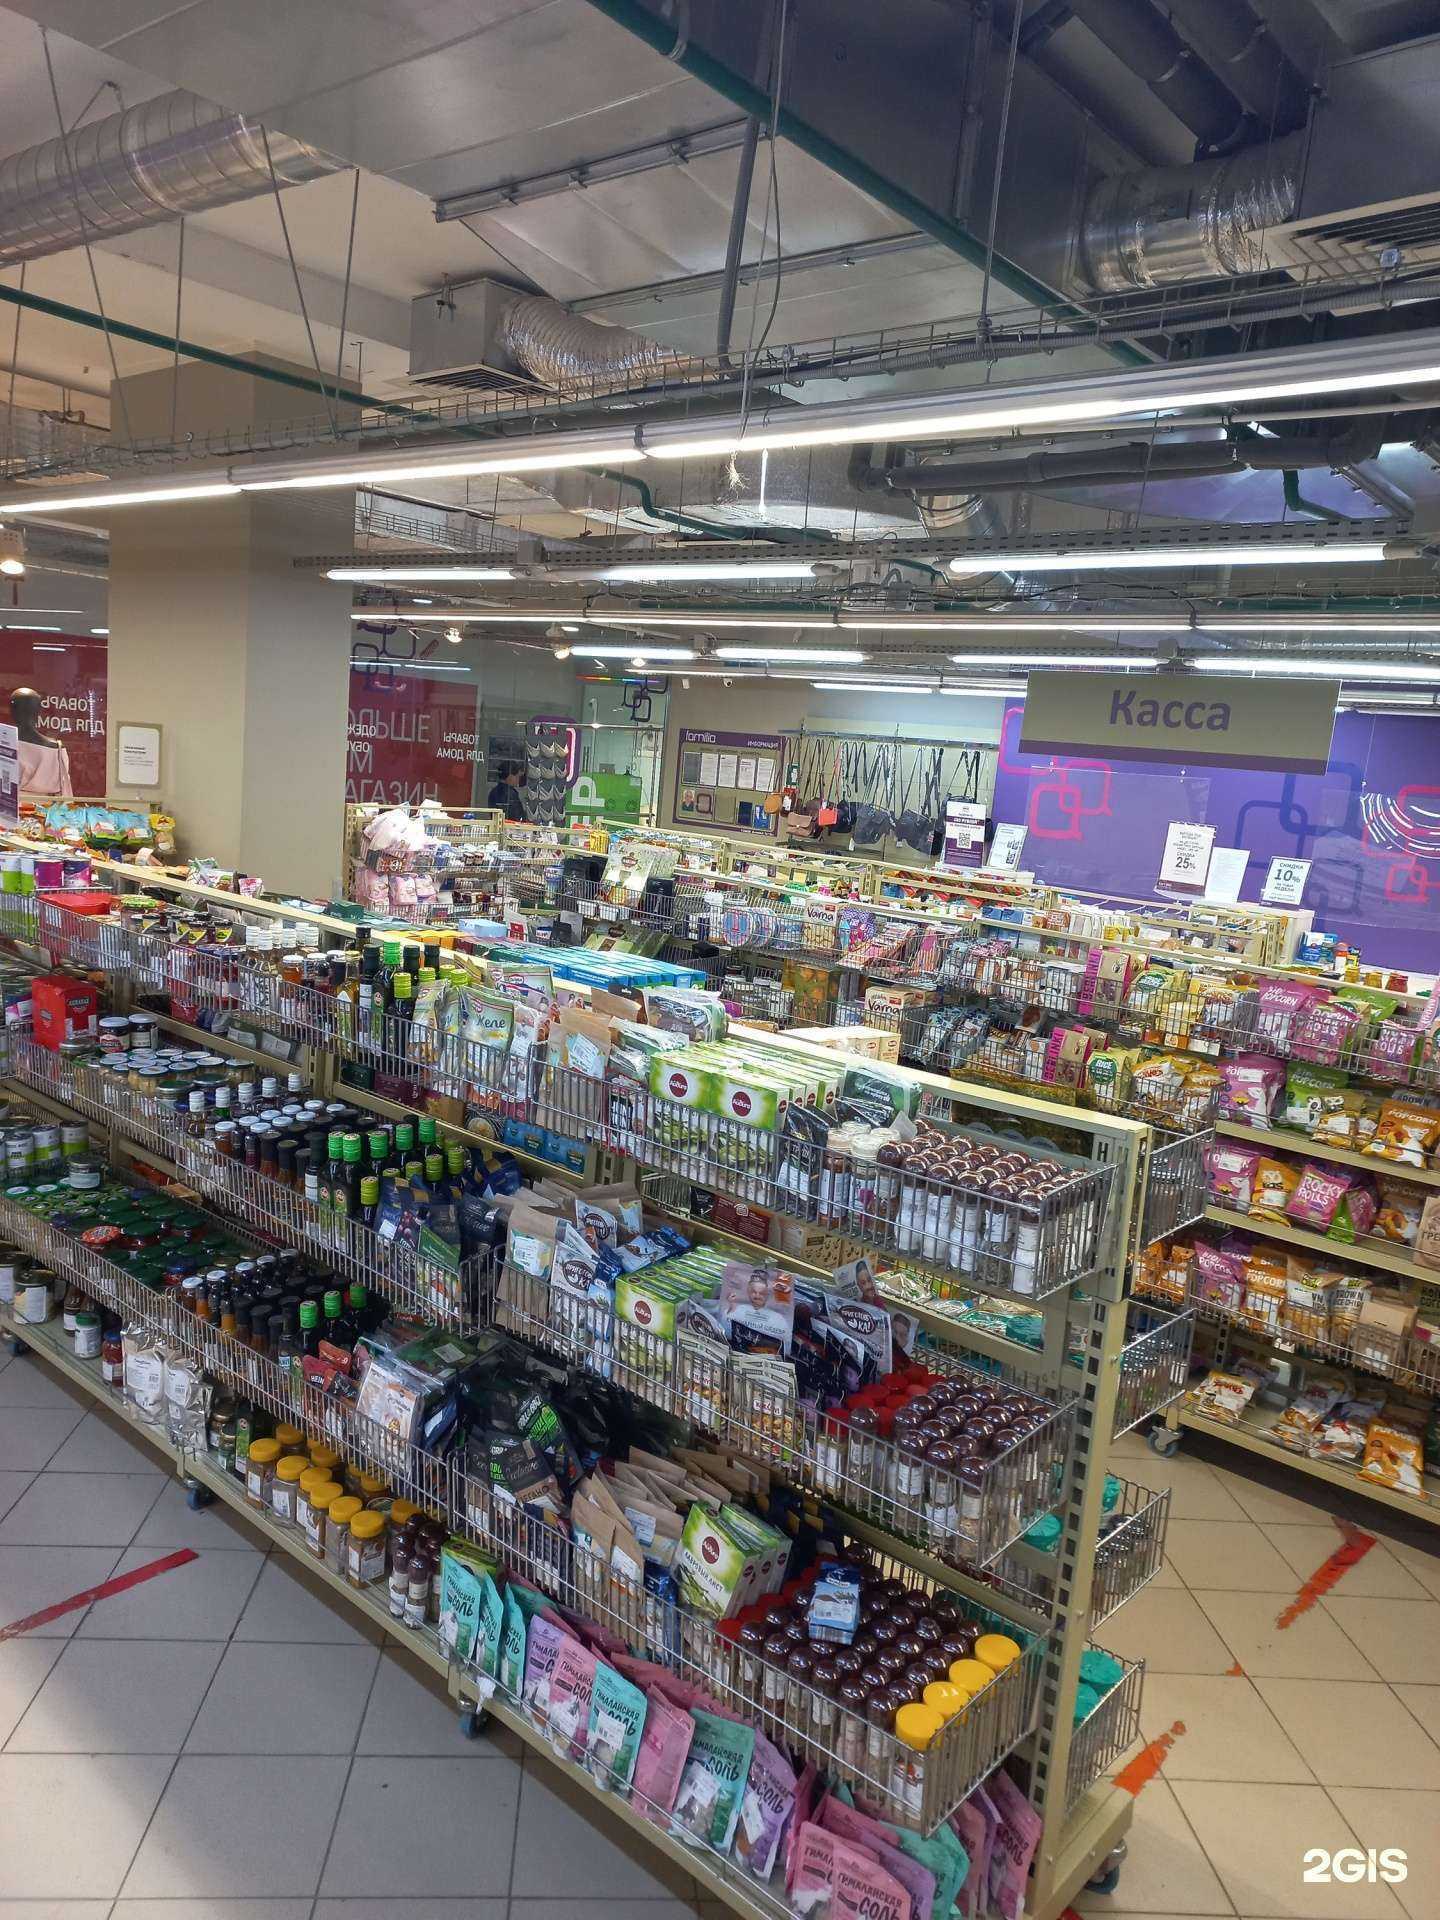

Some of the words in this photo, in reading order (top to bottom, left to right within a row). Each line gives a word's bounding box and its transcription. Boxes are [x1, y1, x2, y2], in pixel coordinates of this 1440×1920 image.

[1109, 690, 1231, 731] Касса
[1175, 856, 1197, 871] 25%
[1274, 868, 1301, 883] 10%
[807, 907, 834, 922] Varna
[868, 999, 900, 1016] Varna
[573, 1683, 593, 1706] СОЛ
[595, 1688, 640, 1721] ГИМАЛАЙСКАЯ
[708, 1755, 740, 1781] СОЛЬ
[756, 1781, 784, 1815] СОЛЬ
[838, 1872, 903, 1906] ГИМАЛАЙСКАЯ
